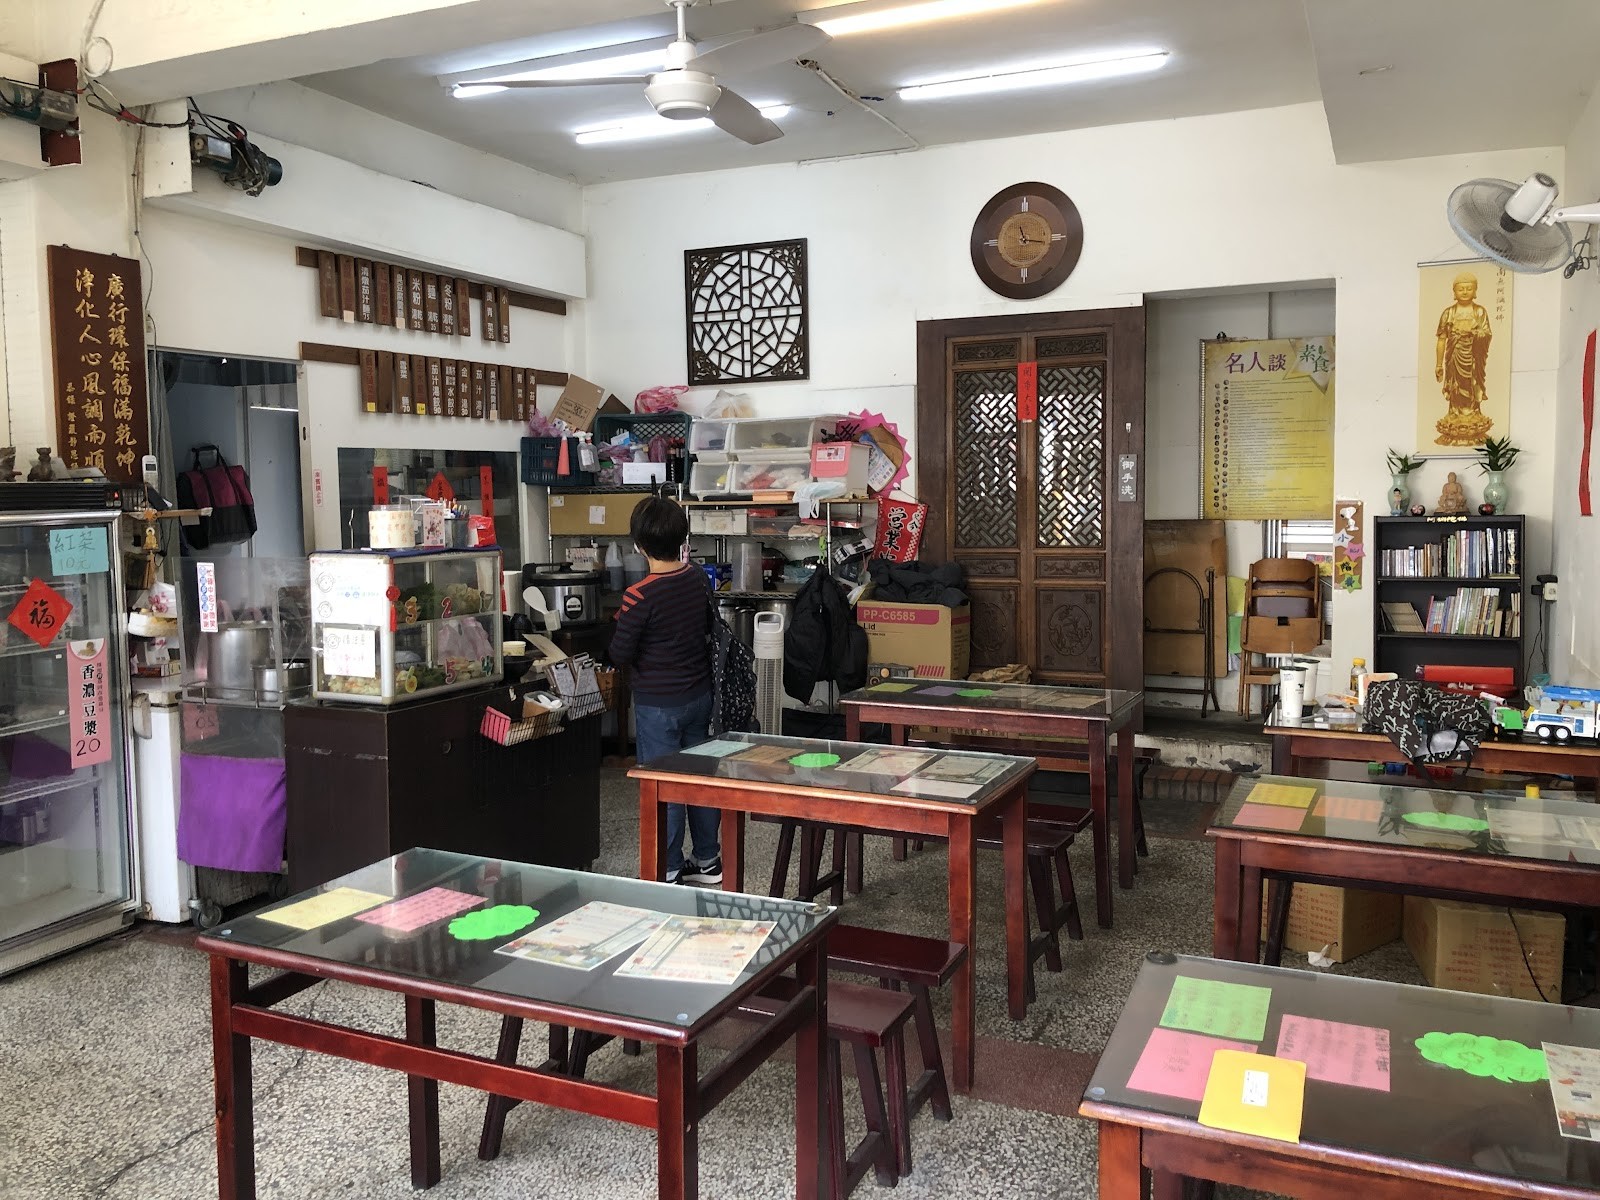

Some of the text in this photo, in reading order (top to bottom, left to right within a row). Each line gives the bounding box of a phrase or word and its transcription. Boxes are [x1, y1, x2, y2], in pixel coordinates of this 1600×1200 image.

[411, 277, 421, 305] 米粉
[444, 284, 453, 311] 冬粉
[1495, 266, 1506, 322] 南無阿彌陀佛
[413, 321, 421, 329] 35
[430, 323, 437, 331] 35
[444, 325, 452, 333] 35
[74, 267, 106, 474] 淨化人心風調雨順
[1225, 351, 1287, 374] 名人談
[1299, 344, 1330, 373] 素食
[106, 273, 137, 476] 廣行環保福滿乾坤
[475, 369, 483, 410] 茄汁湯
[402, 405, 411, 413] 70
[460, 407, 468, 416] 30
[1121, 460, 1135, 496] 御手洗
[54, 530, 96, 554] 紅茶
[1337, 533, 1349, 543] 小
[30, 598, 56, 630] 福
[405, 596, 418, 625] 3
[441, 597, 452, 620] 2
[863, 609, 916, 621] PP-C6585
[445, 658, 457, 685] 5
[81, 663, 98, 738] 香濃豆漿
[76, 738, 101, 758] 20
